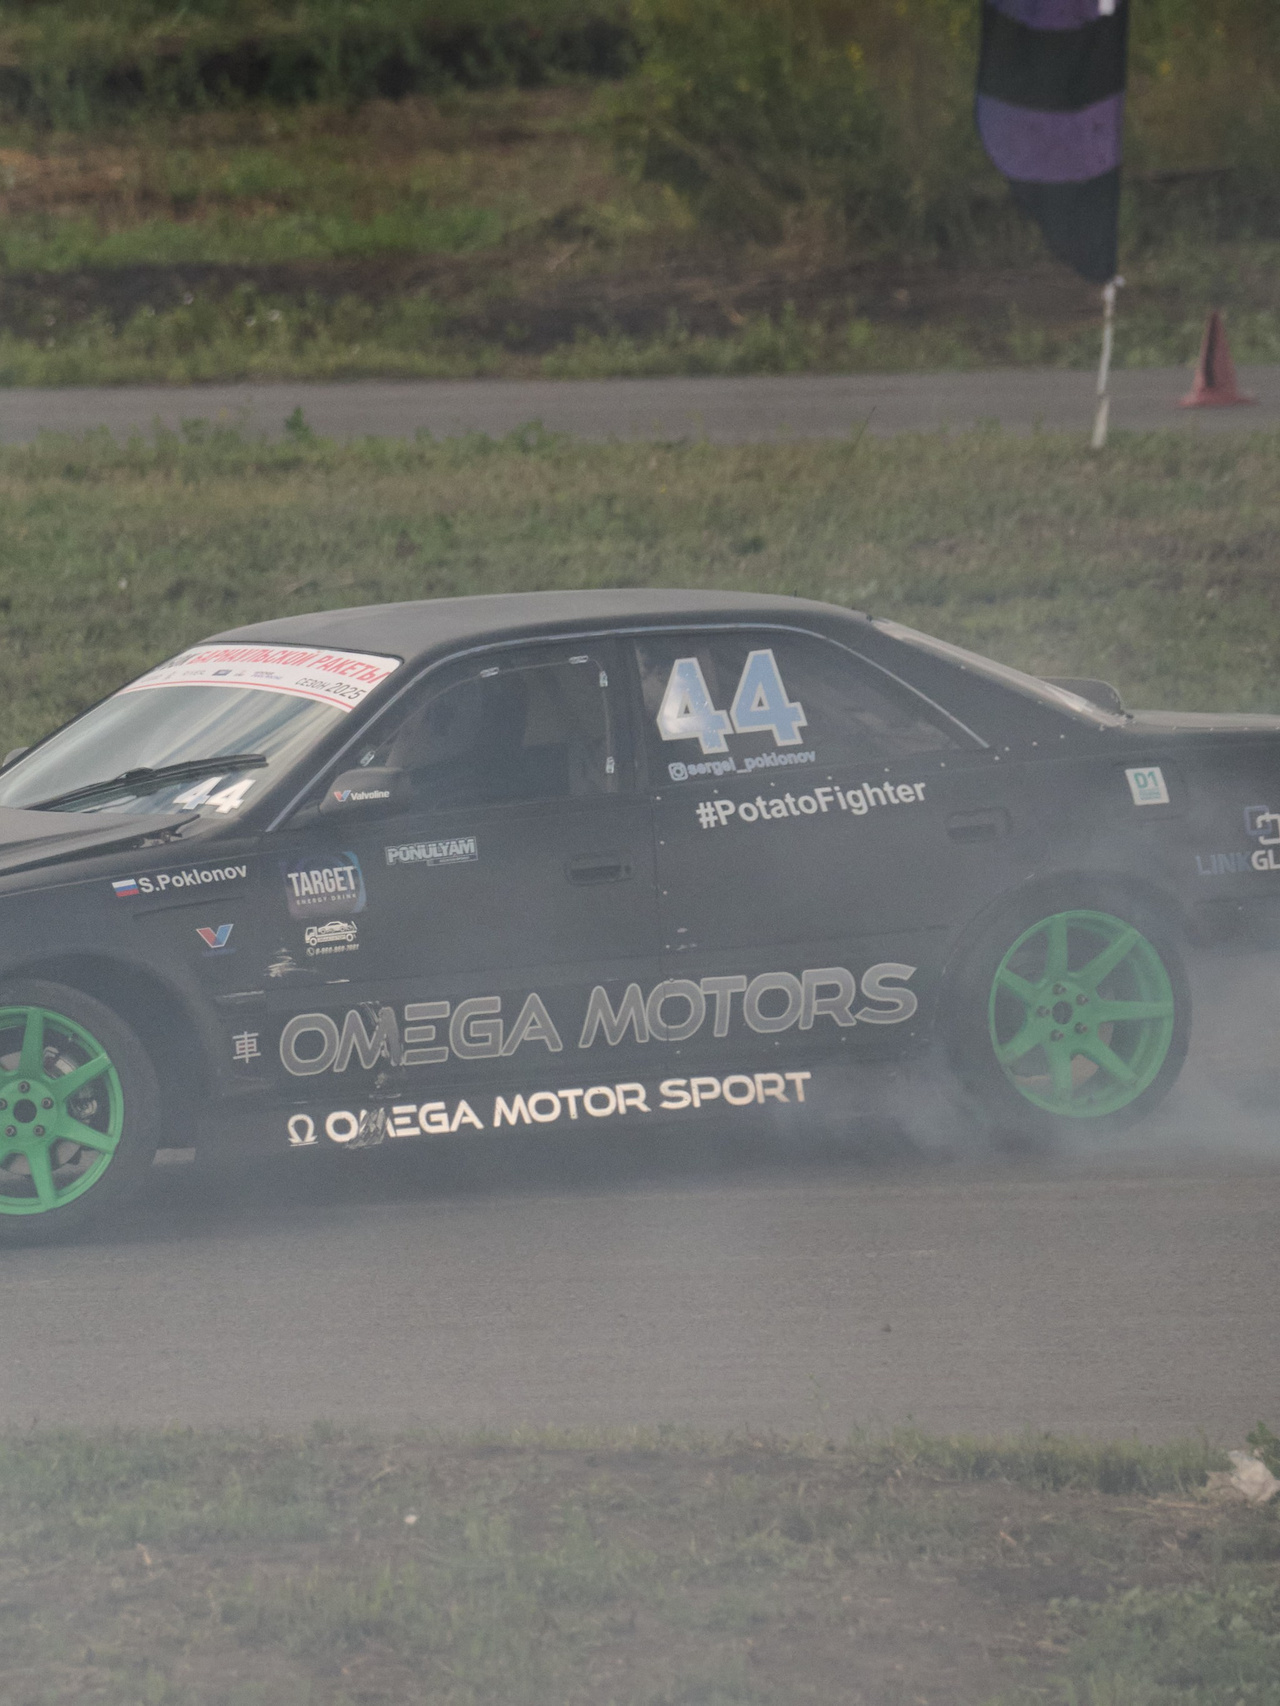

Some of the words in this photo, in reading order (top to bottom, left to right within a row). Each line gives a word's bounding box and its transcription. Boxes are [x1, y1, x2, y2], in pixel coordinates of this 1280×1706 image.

[309, 652, 391, 683] РАКЕТЫ
[295, 677, 328, 690] СЕЗОН
[326, 682, 367, 699] 2025
[656, 649, 808, 754] 44
[172, 776, 256, 814] 44
[350, 790, 390, 801] Valvoline
[696, 782, 926, 829] #PotatoFighter
[387, 839, 475, 863] PONULYAM
[138, 865, 247, 893] S.Poklonov
[287, 865, 355, 897] TARGET
[296, 896, 327, 905] ENERGY
[331, 893, 357, 901] DRINK
[280, 992, 563, 1076] OMEGA
[578, 962, 919, 1048] MOTORS
[232, 1031, 261, 1063] 車
[494, 1081, 651, 1127] MOTOR
[660, 1072, 812, 1109] SPORT
